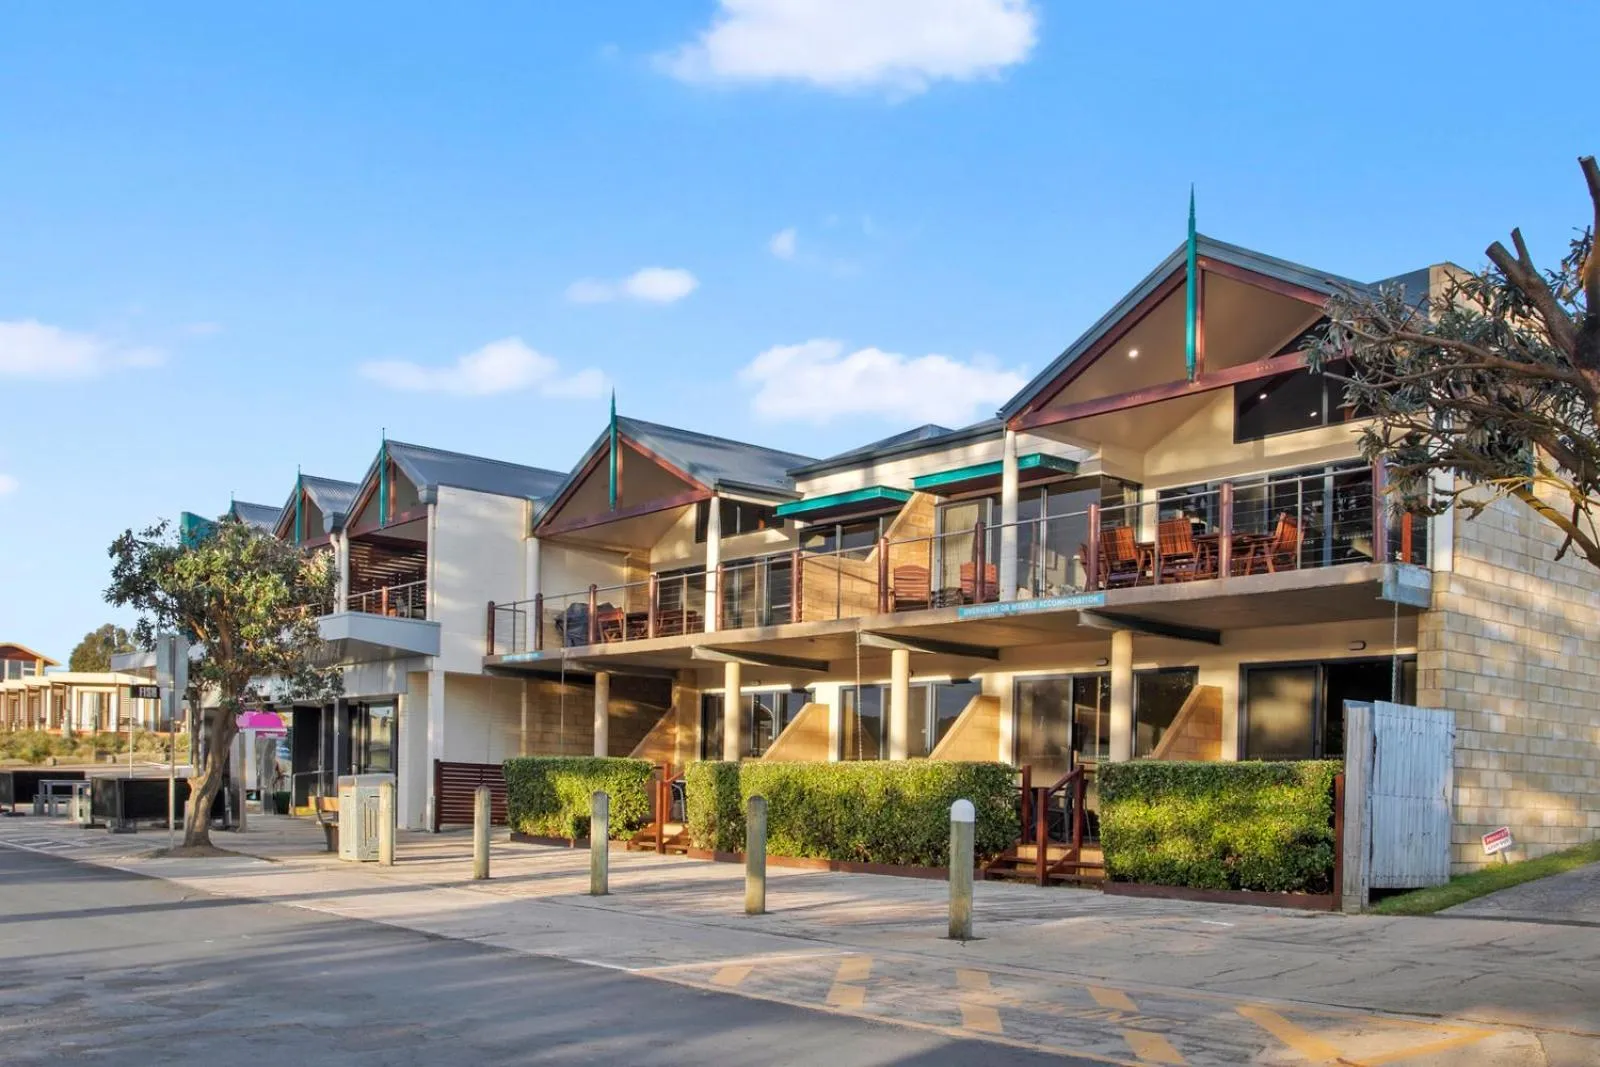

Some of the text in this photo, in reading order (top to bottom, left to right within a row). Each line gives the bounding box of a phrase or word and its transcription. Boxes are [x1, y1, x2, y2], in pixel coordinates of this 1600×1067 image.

[963, 606, 999, 617] OVERNIGHT
[1000, 604, 1010, 612] OR
[1039, 597, 1098, 608] ACCOMMODATION
